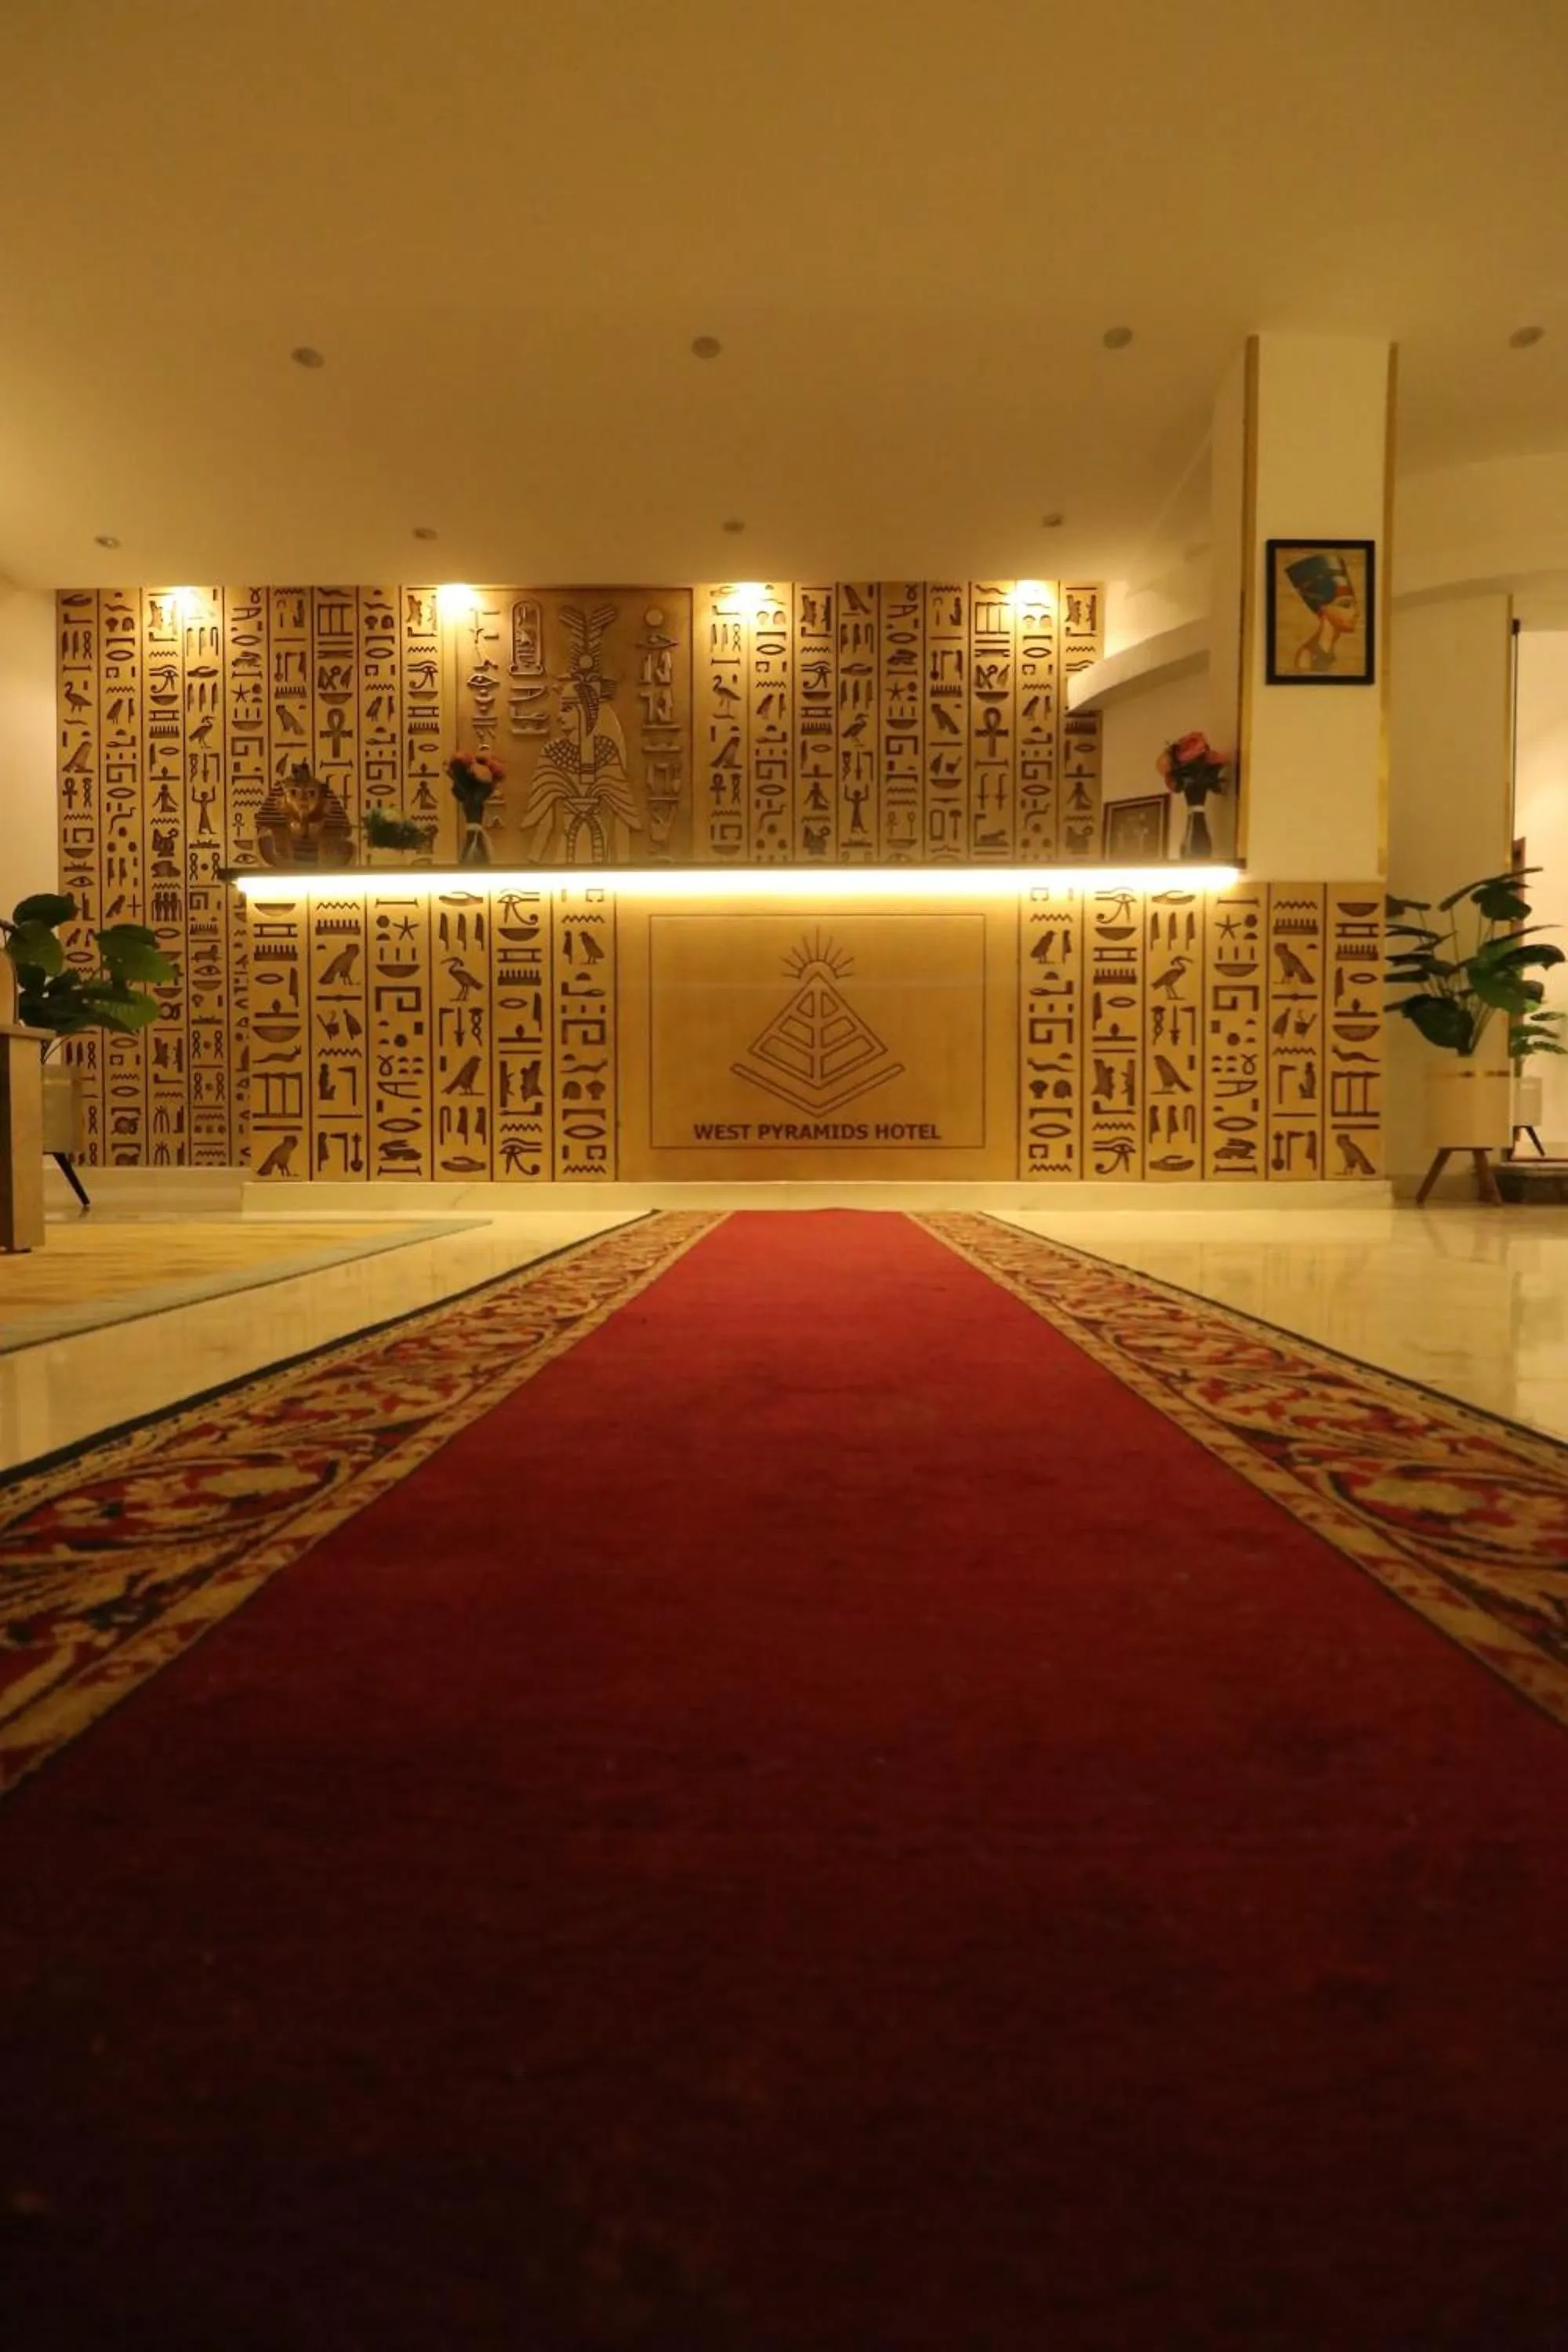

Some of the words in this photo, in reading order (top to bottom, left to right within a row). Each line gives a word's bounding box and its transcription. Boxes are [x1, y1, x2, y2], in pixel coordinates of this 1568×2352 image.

[694, 1123, 752, 1140] WEST
[758, 1123, 868, 1140] PYRAMIDS
[875, 1123, 942, 1140] HOTEL
